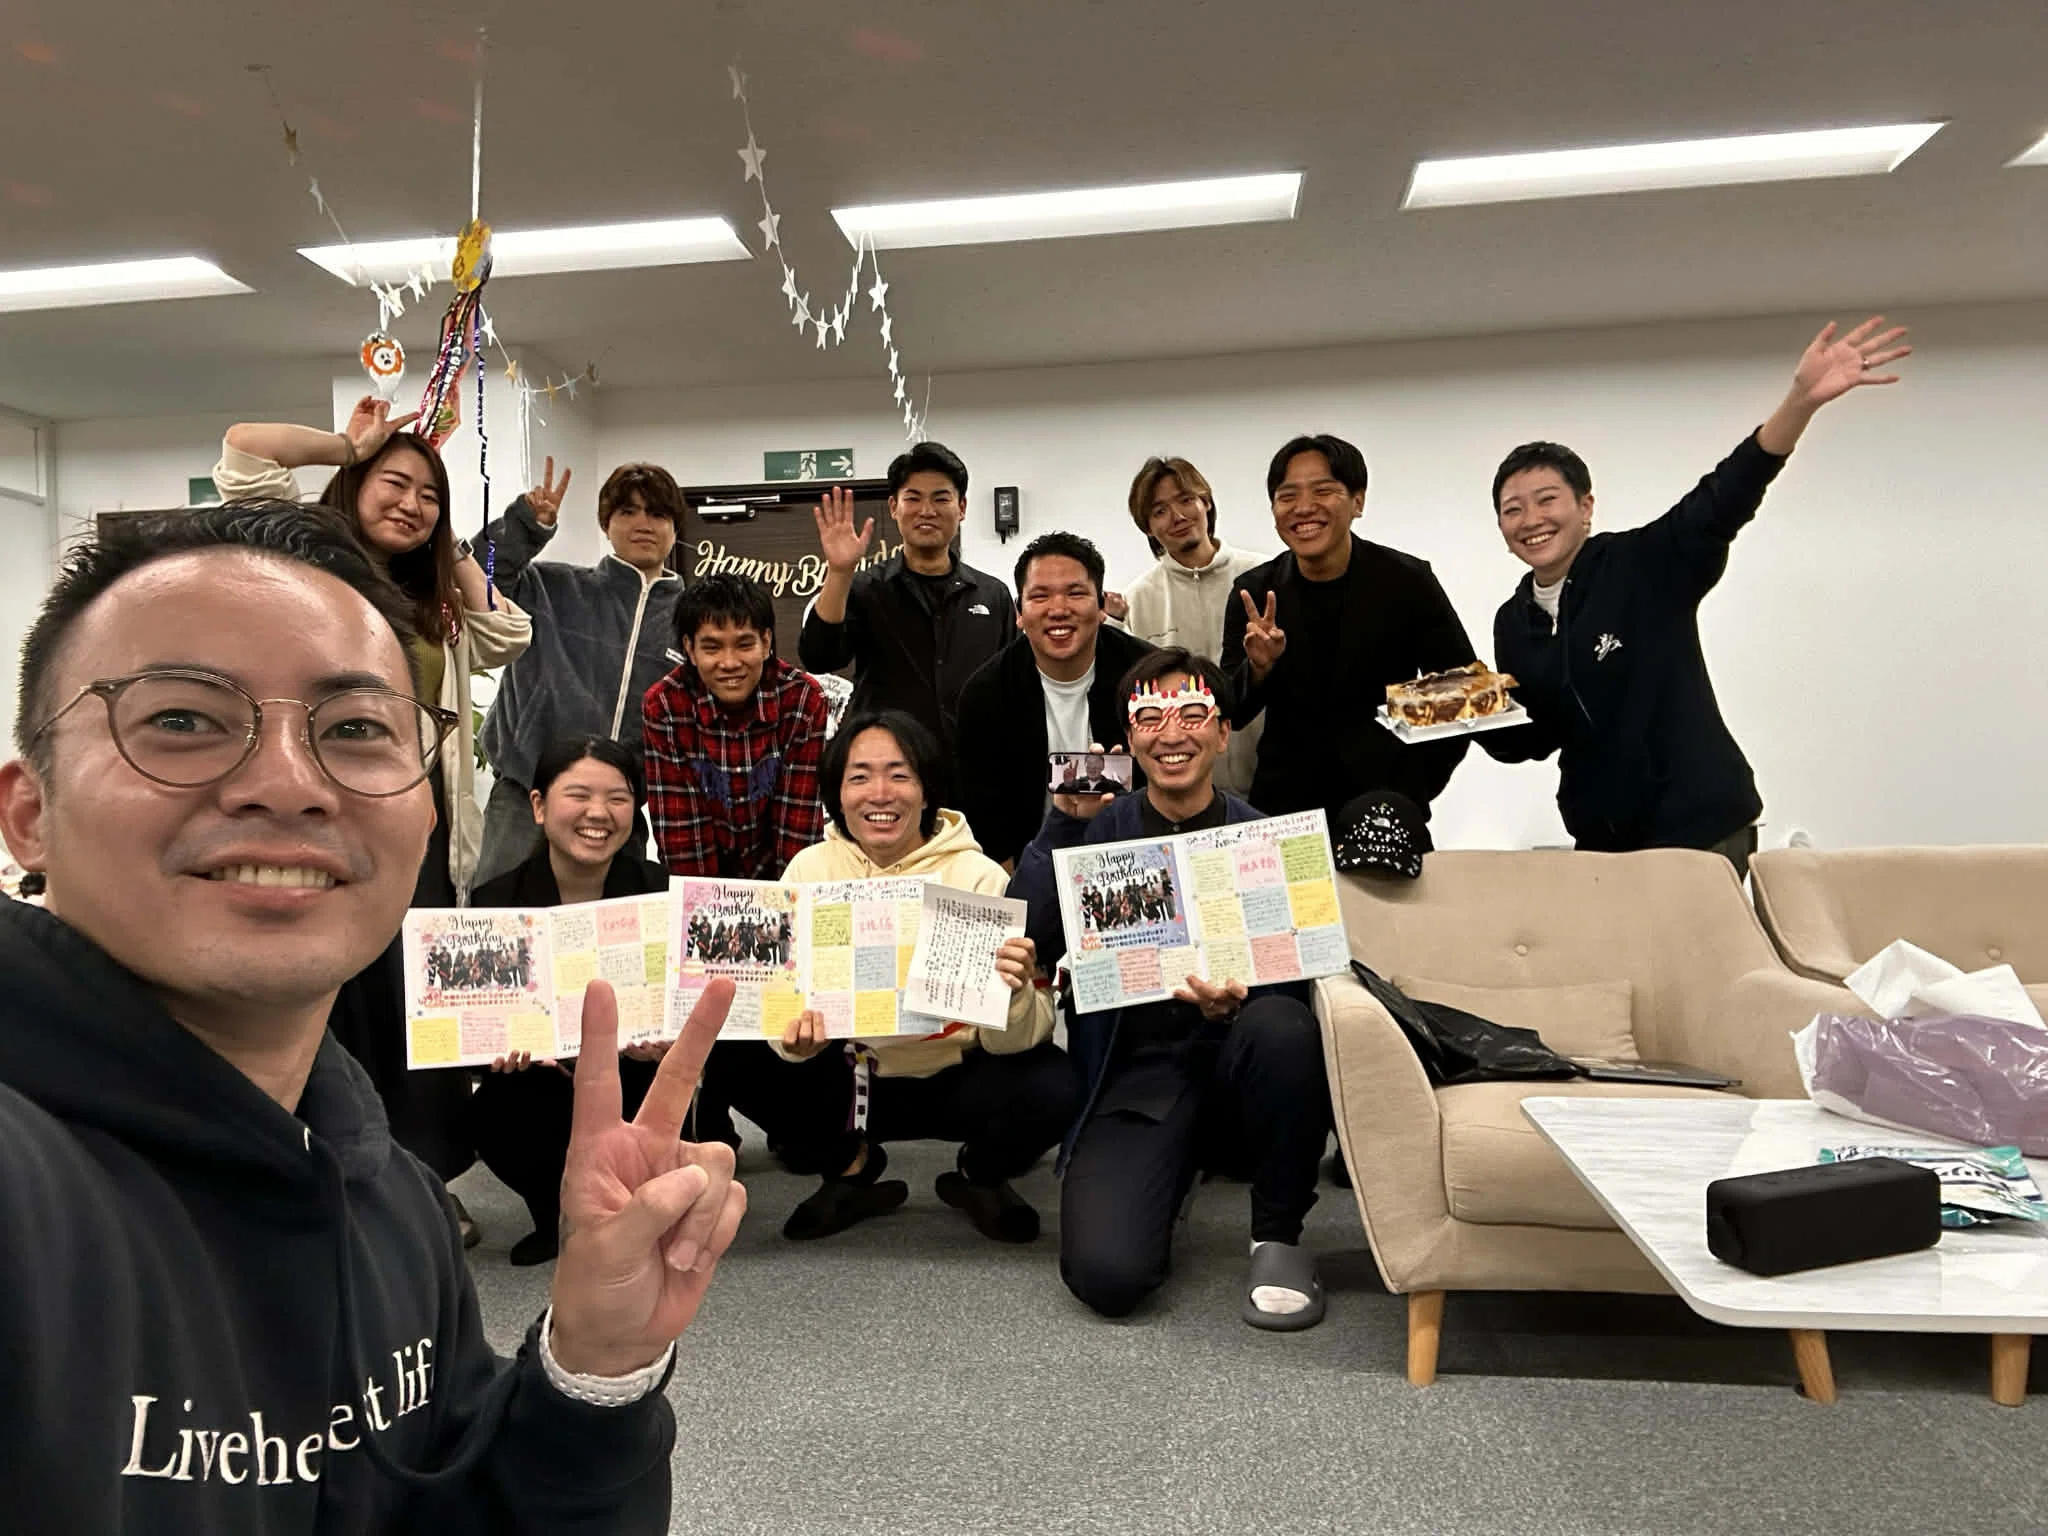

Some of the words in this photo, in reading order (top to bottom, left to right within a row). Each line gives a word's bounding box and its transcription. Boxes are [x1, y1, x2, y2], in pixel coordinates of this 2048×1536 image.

[1096, 850, 1136, 869] Happy
[712, 883, 756, 904] Happy
[447, 914, 495, 932] Happy
[392, 1337, 433, 1417] lif
